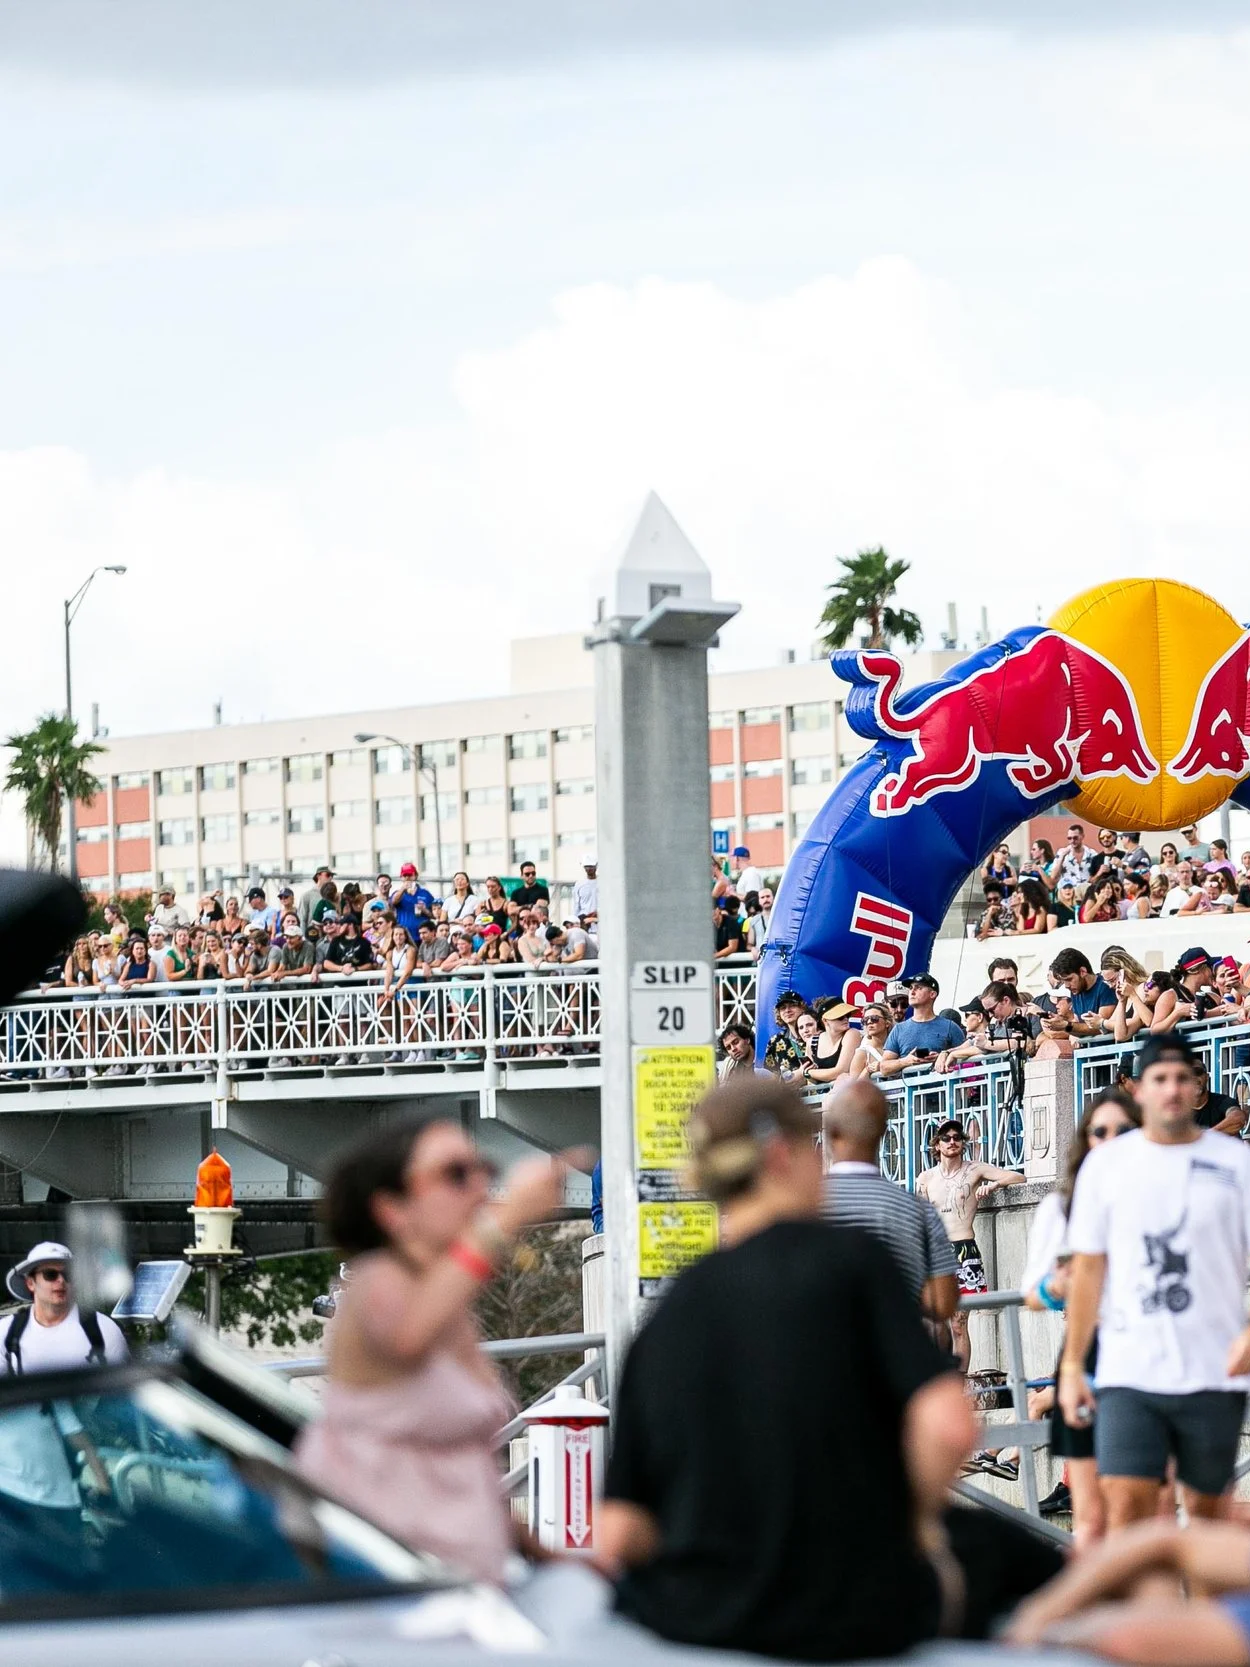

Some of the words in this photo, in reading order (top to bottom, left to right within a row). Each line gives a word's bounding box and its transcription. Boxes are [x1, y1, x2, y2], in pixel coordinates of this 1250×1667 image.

[714, 833, 727, 853] H
[843, 892, 912, 1022] Bull
[644, 966, 697, 984] SLIP
[658, 1006, 684, 1031] 20
[566, 1434, 589, 1443] FIRE
